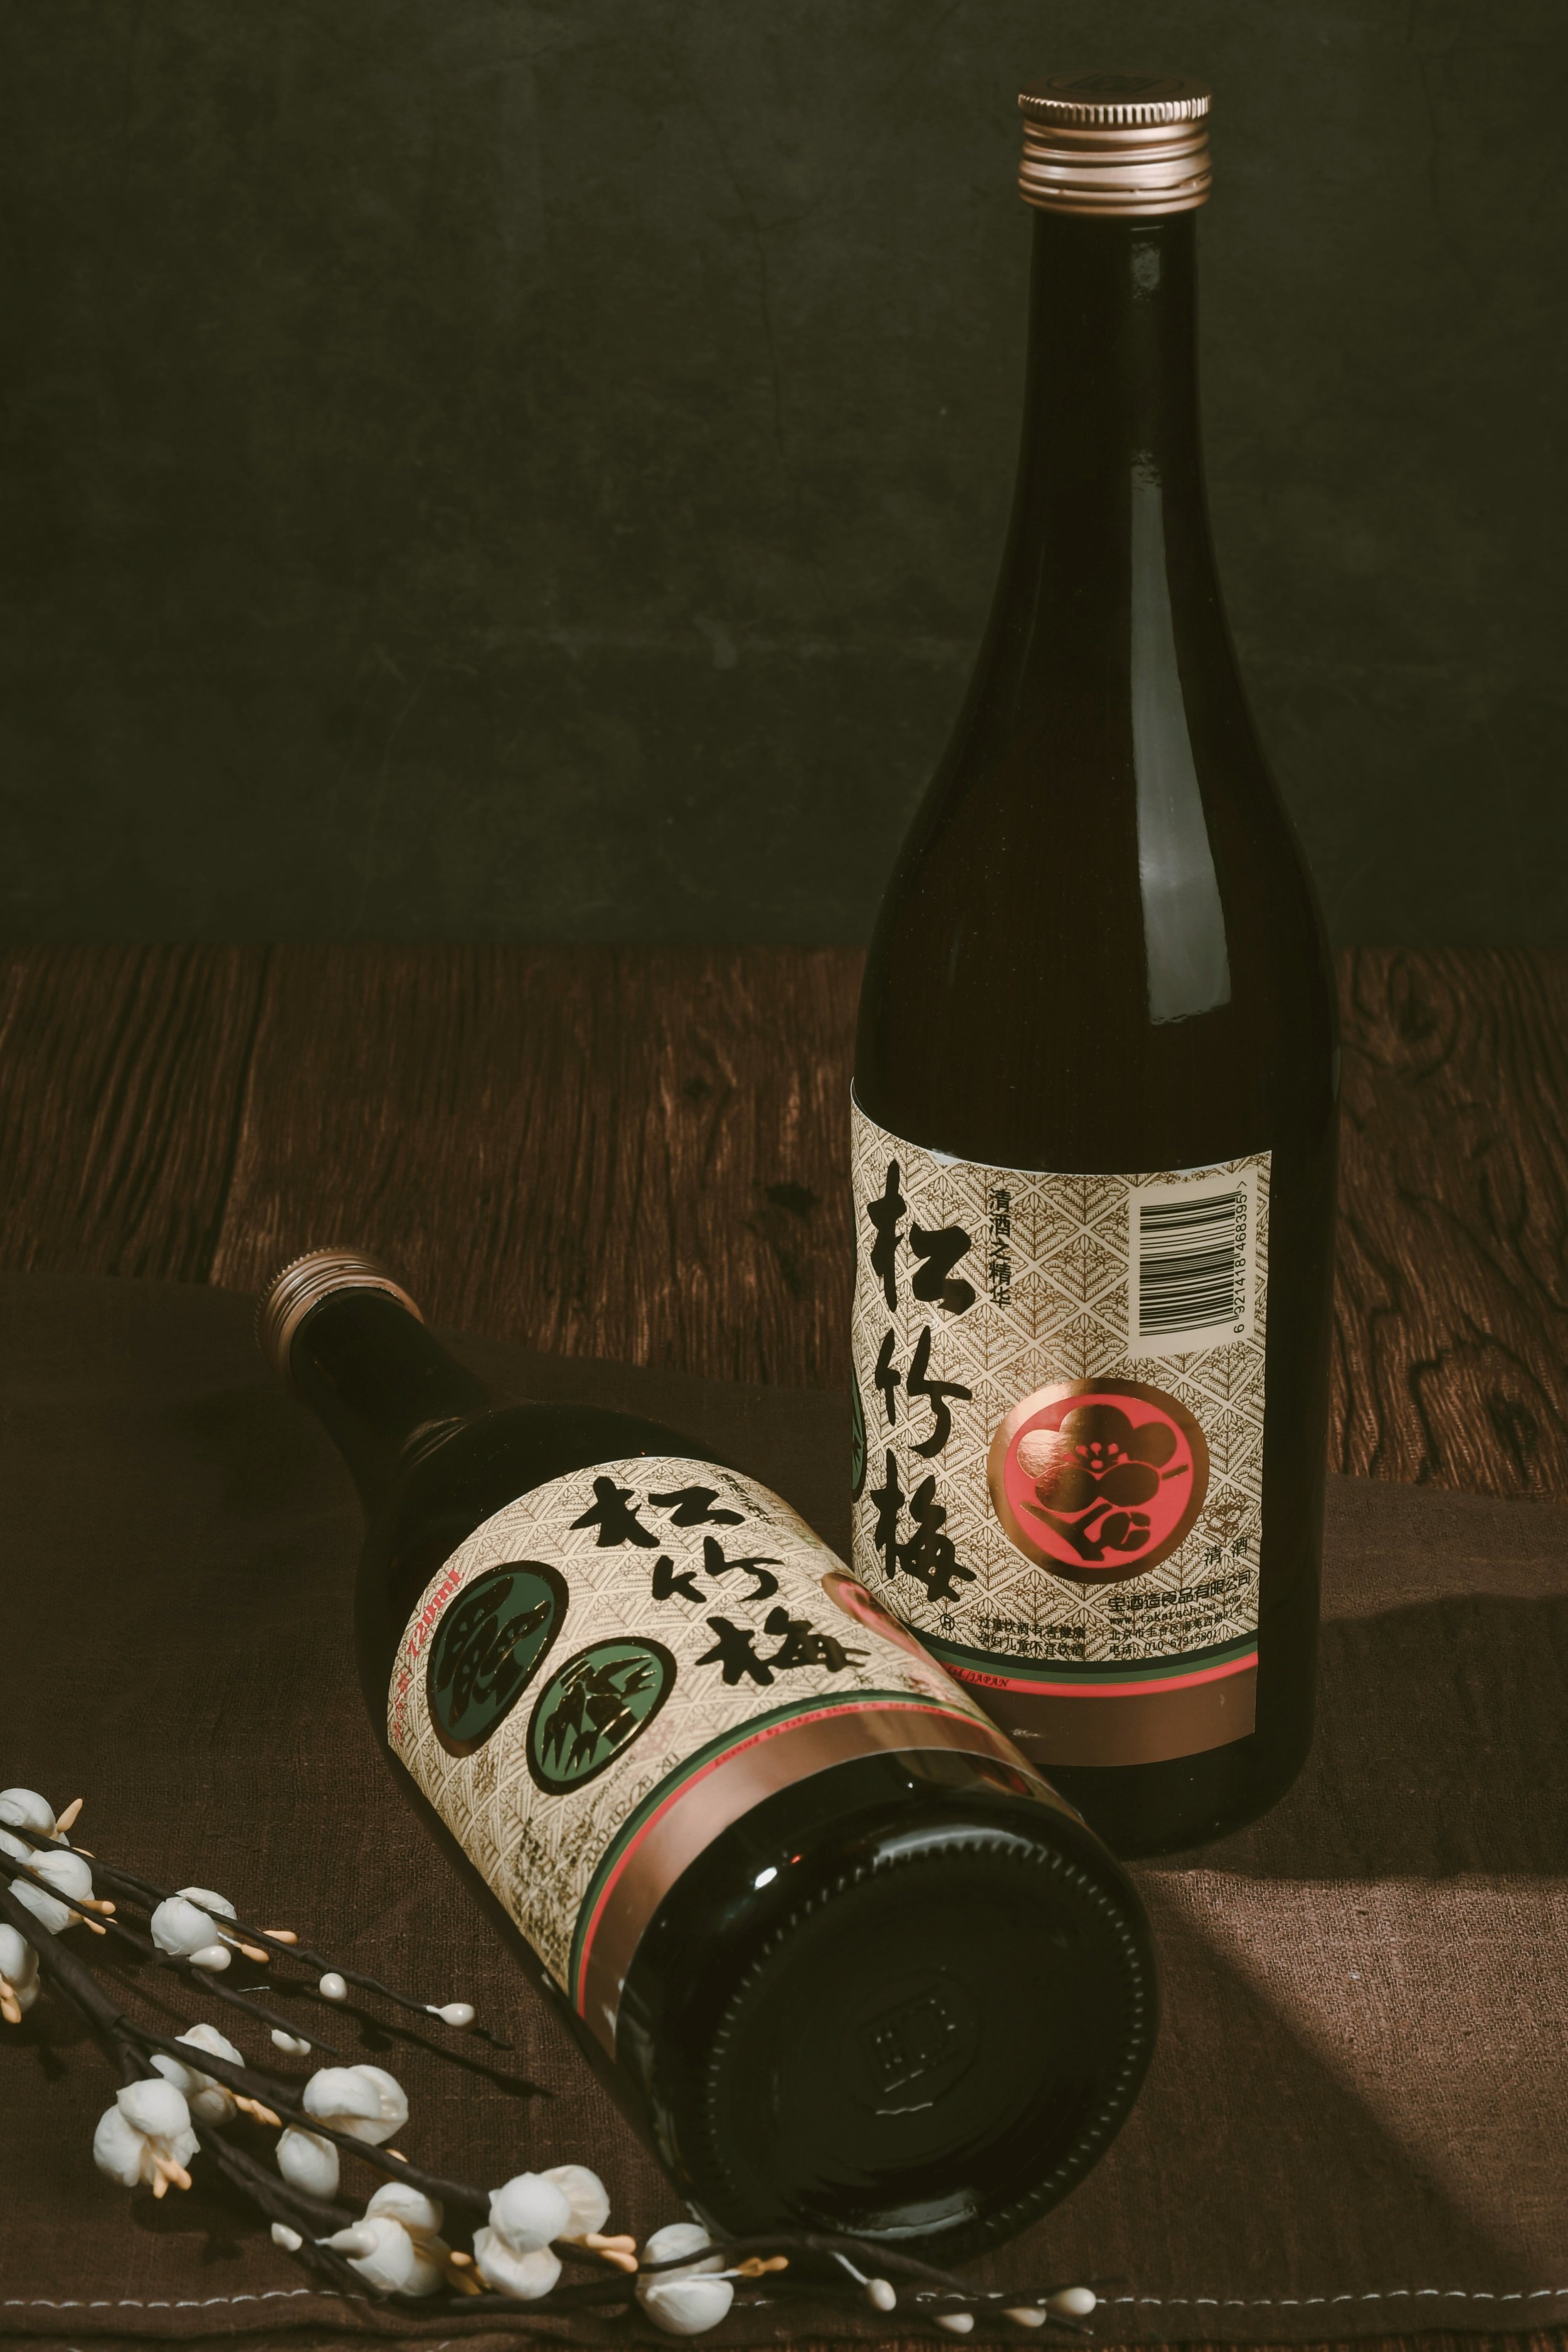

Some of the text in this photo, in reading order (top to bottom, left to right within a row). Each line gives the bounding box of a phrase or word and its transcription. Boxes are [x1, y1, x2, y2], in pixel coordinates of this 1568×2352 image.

[988, 1187, 1012, 1309] 清酒之精华
[1236, 1194, 1248, 1251] 468395
[1234, 1258, 1246, 1316] 921418
[867, 1158, 977, 1603] 松竹梅
[1204, 1535, 1249, 1566] 清酒
[568, 1475, 872, 1687] 松竹梅
[1108, 1569, 1251, 1613] 宝酒造食品有限公司
[978, 1616, 1086, 1639] 过量饮酒有害健康
[978, 1632, 1085, 1656] 孕妇儿童不宜饮酒
